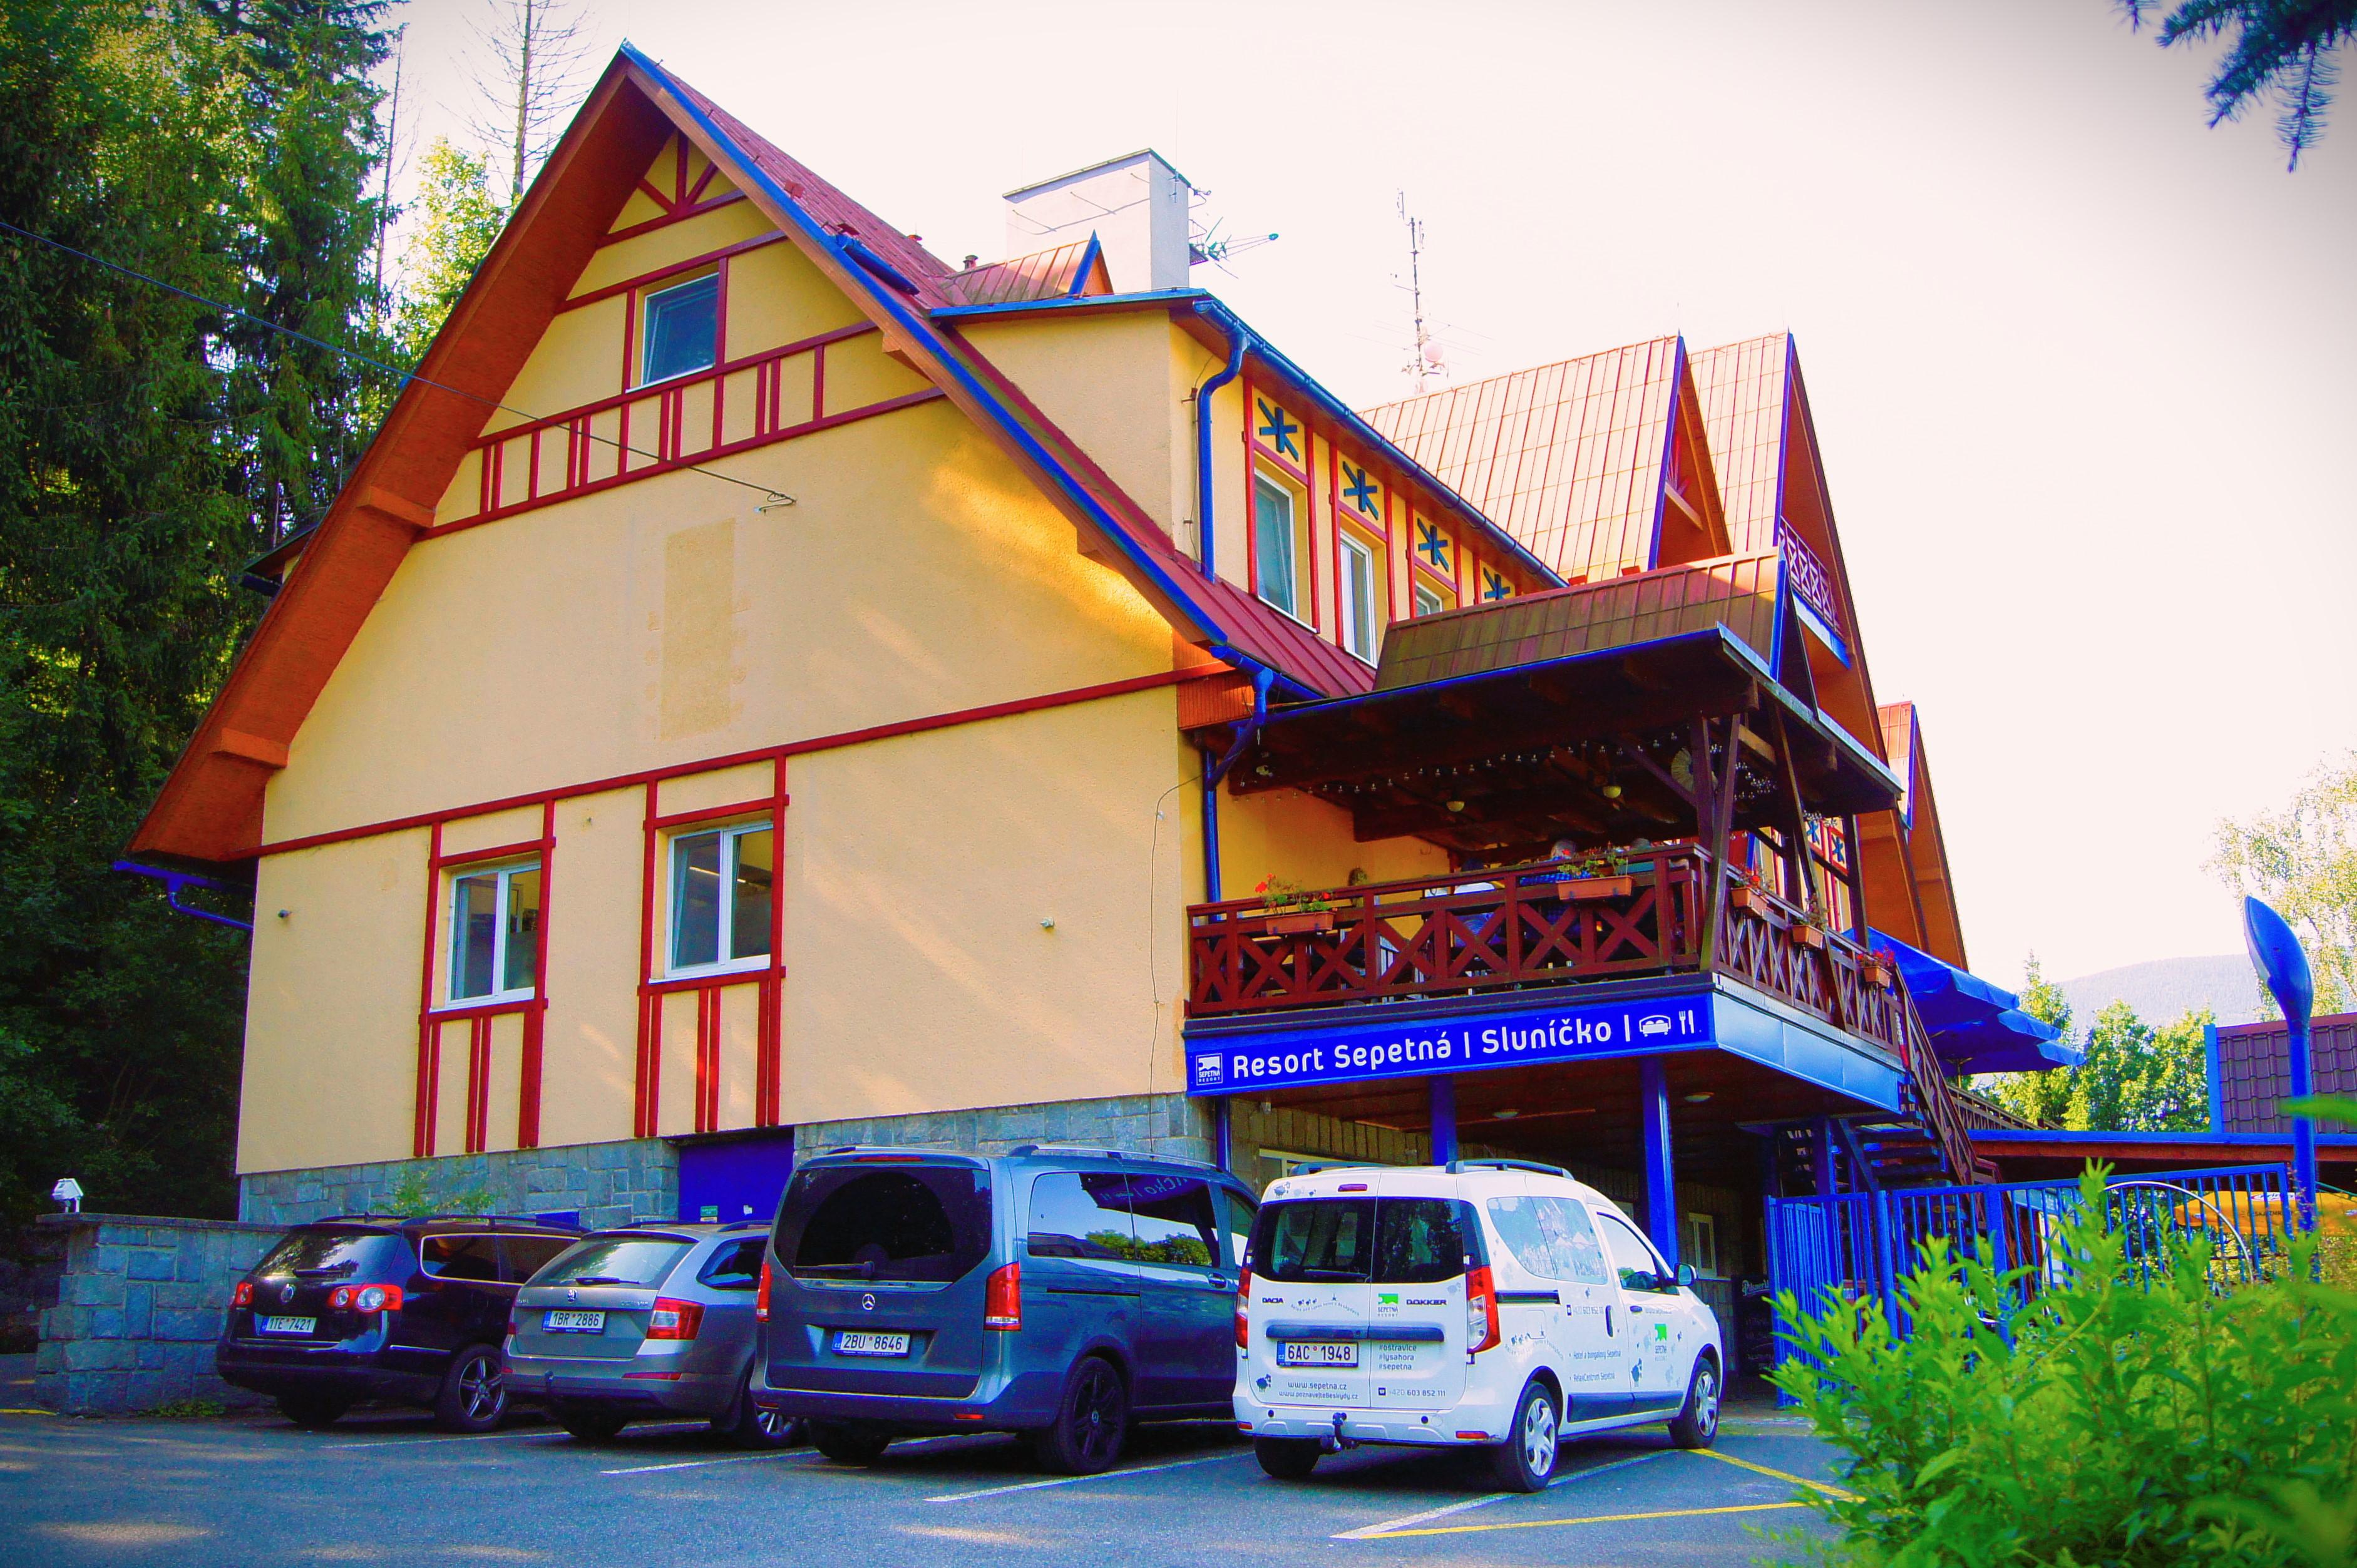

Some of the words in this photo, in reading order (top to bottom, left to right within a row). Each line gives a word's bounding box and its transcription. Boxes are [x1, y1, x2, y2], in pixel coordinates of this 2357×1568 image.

[1233, 1048, 1324, 1079] Resort
[1334, 1032, 1452, 1070] Sepetná
[1481, 1018, 1611, 1054] Sluníčko
[270, 1318, 282, 1329] 1TE
[289, 1318, 311, 1332] 7421
[553, 1313, 570, 1326] 1BR
[576, 1313, 600, 1326] 2886
[844, 1335, 866, 1349] 2BU
[873, 1336, 903, 1350] 8646
[1288, 1345, 1310, 1360] 6AC
[1321, 1346, 1350, 1361] 1948
[1379, 1353, 1415, 1362] #lysahora
[1288, 1381, 1347, 1390] www.sepetna.cz
